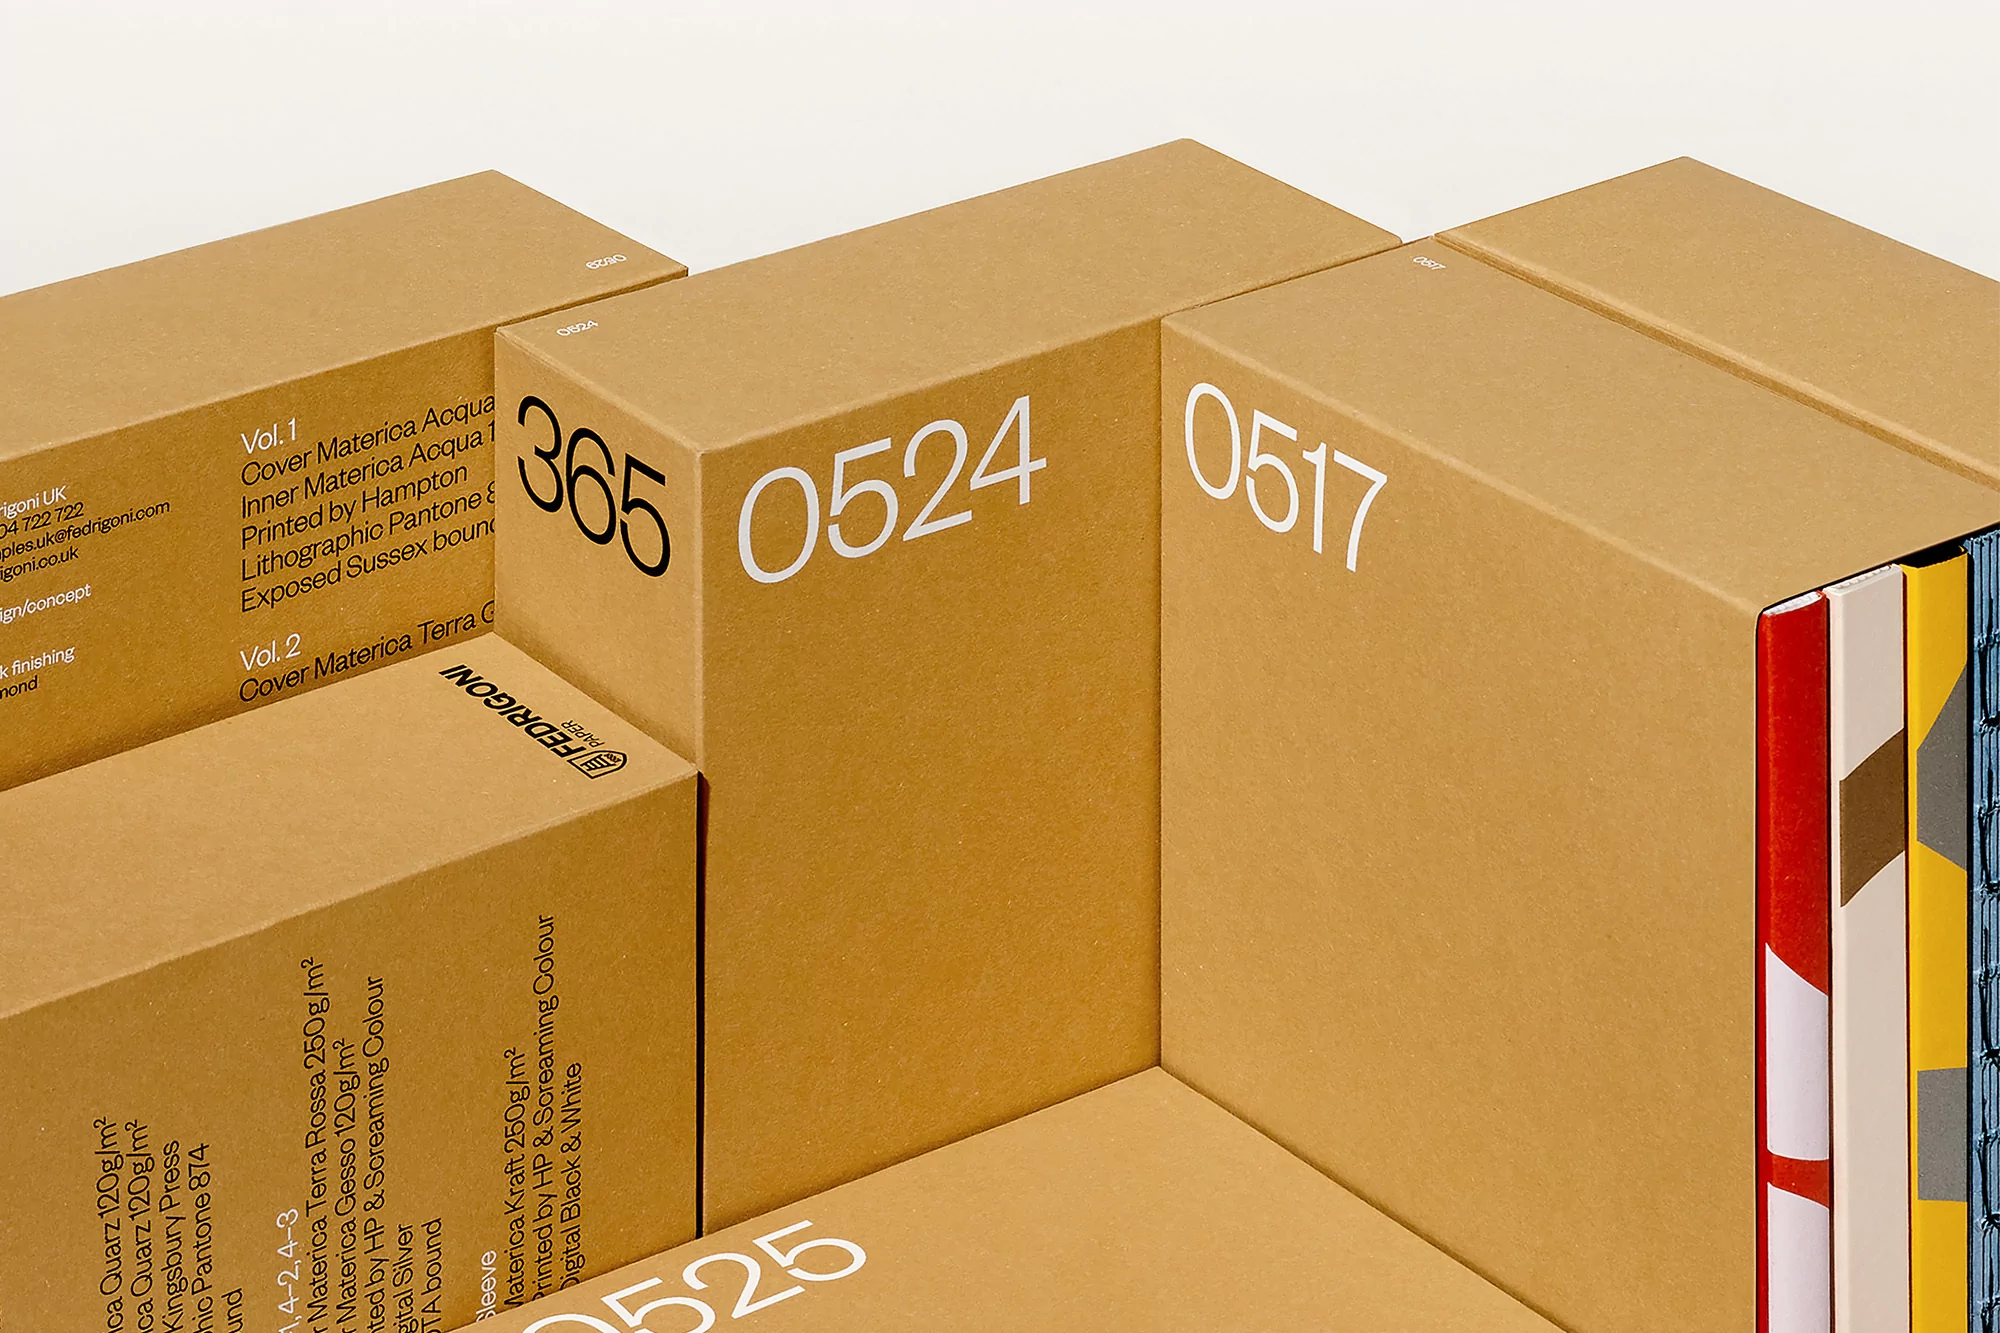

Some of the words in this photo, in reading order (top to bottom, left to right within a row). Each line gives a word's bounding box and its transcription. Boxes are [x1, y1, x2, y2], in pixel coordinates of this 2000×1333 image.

[585, 254, 627, 269] 0529
[1413, 256, 1446, 270] 0517
[556, 320, 599, 336] 0524
[240, 423, 284, 454] Vol.
[288, 417, 296, 441] 1
[241, 450, 312, 486] Cover
[317, 420, 417, 464] Materica
[421, 395, 495, 432] Acqua
[43, 485, 67, 505] UK
[242, 486, 299, 519] Inner
[304, 455, 404, 499] Materica
[408, 430, 484, 468] Acqua
[242, 503, 323, 550] Printed
[329, 500, 357, 523] by
[362, 465, 467, 513] Hampton
[517, 394, 671, 578] 365
[738, 395, 1047, 584] 0524
[1184, 383, 1387, 573] 0517
[0, 501, 170, 562] ples.uk@fedrigoni.com
[22, 511, 51, 532] 722
[55, 502, 84, 522] 722
[242, 520, 384, 581] Lithographic
[389, 492, 482, 535] Pantone
[0, 583, 91, 624] ign/concept
[242, 560, 341, 613] Exposed
[346, 539, 427, 578] Sussex
[12, 646, 75, 676] finishing
[239, 640, 281, 671] Vol.
[285, 633, 301, 657] 2
[239, 665, 309, 702] Cover
[314, 633, 413, 680] Materica
[417, 613, 477, 645] Terra
[438, 664, 587, 758] FEDRIGONI
[560, 719, 605, 748] PAPER
[533, 915, 554, 995] Colour
[362, 976, 384, 1058] Colour
[533, 995, 559, 1126] Screaming
[305, 1069, 326, 1149] Rossa
[363, 1057, 389, 1190] Screaming
[561, 1062, 582, 1134] White
[188, 1143, 210, 1191] 874
[532, 1125, 554, 1148] &
[532, 1153, 553, 1190] HP
[560, 1131, 582, 1154] &
[159, 1140, 181, 1213] Press
[305, 1148, 327, 1217] Terra
[334, 1138, 356, 1217] Gesso
[363, 1189, 385, 1212] &
[504, 1154, 525, 1215] Kraft
[532, 1194, 557, 1223] by
[560, 1155, 581, 1223] Black
[100, 1218, 122, 1295] Quarz
[131, 1219, 153, 1297] Quarz
[191, 1192, 212, 1295] Pantone
[306, 1215, 328, 1323] Materica
[336, 1217, 357, 1324] Materica
[364, 1217, 385, 1254] HP
[393, 1224, 413, 1287] Silver
[421, 1217, 442, 1295] bound
[160, 1216, 188, 1333] Kingsbury
[364, 1258, 390, 1288] by
[191, 1296, 213, 1333] hic
[421, 1294, 442, 1333] TA
